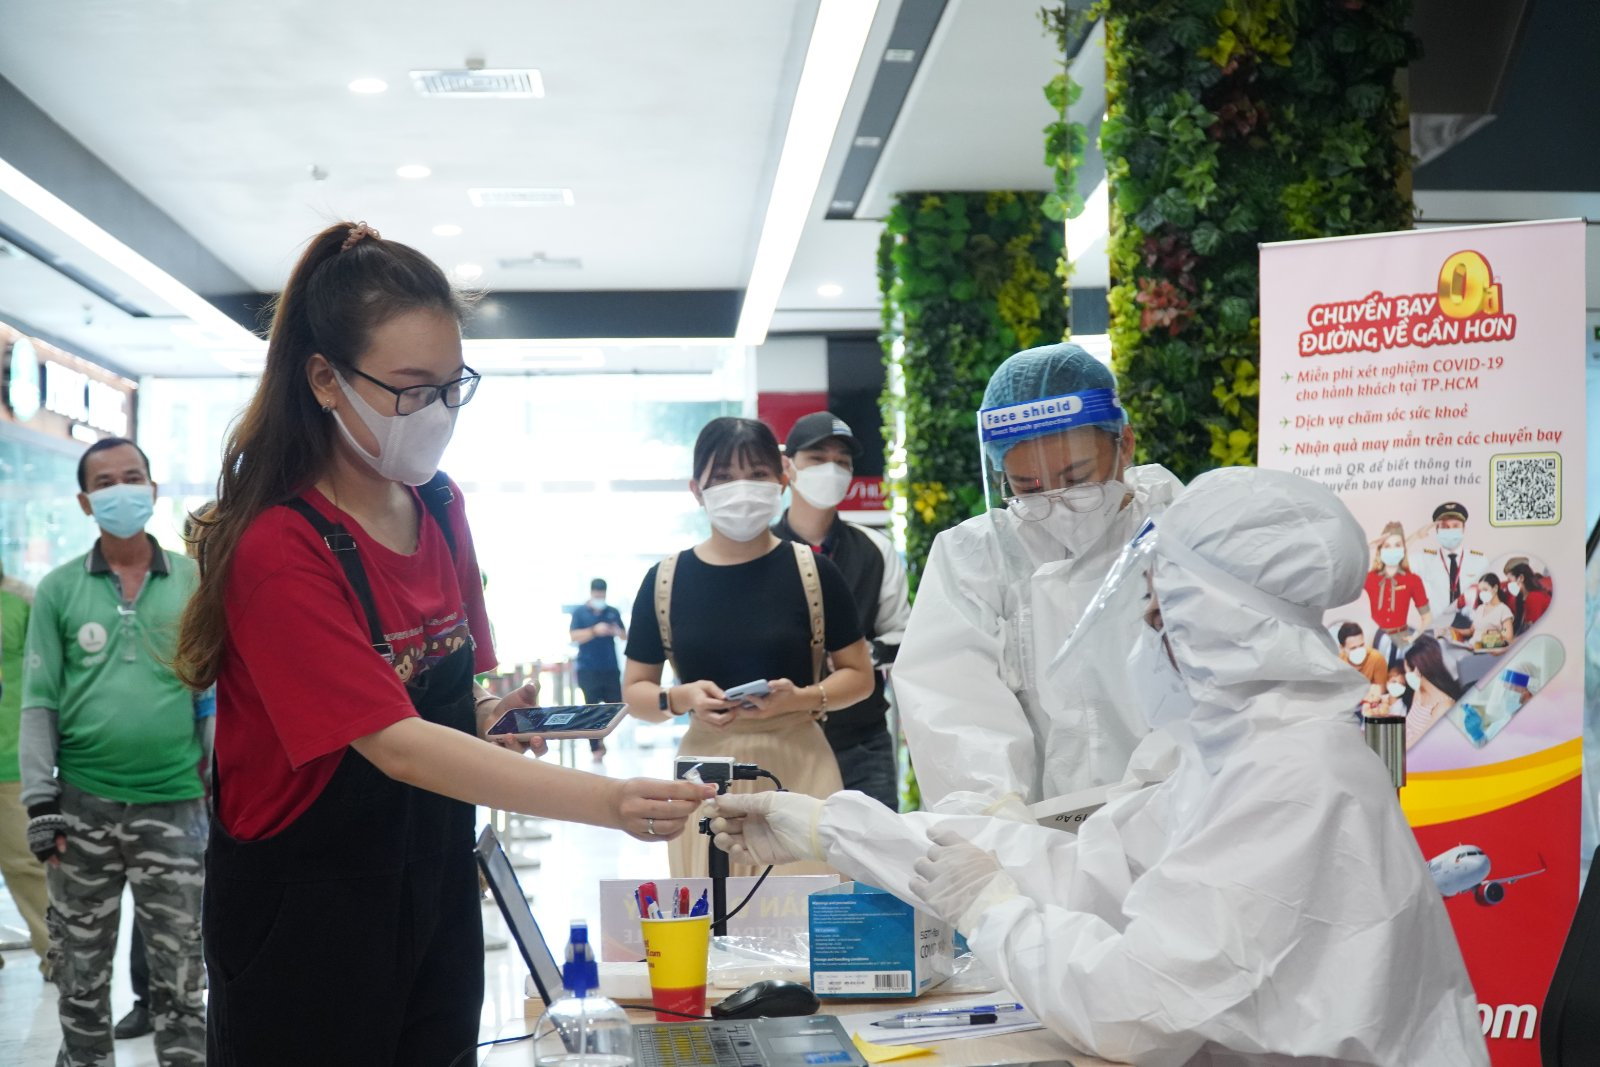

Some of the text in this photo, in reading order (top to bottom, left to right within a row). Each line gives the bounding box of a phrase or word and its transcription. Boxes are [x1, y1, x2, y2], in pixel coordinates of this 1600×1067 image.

[1311, 294, 1392, 327] CHUYẾN
[1396, 297, 1437, 318] BAY
[1301, 315, 1513, 353] ĐƯỜNG VỀ GẦN HƠN
[1297, 356, 1504, 383] Miễn phí xét nghiệm COVID-19
[1296, 376, 1479, 401] cho hành khách tại TP.HCM
[987, 400, 1072, 425] Face shield
[1033, 417, 1073, 430] protection
[1295, 414, 1324, 431] Dịch
[1328, 415, 1344, 429] vụ
[1348, 410, 1383, 424] chăm
[1386, 407, 1406, 422] sóc
[1409, 405, 1431, 419] sức
[1295, 427, 1563, 457] Nhận quà may mắn trên các chuyến bay
[1292, 457, 1472, 477] Quét mã QR để biết thông tin
[1323, 473, 1482, 492] uyến bay đang khai thác
